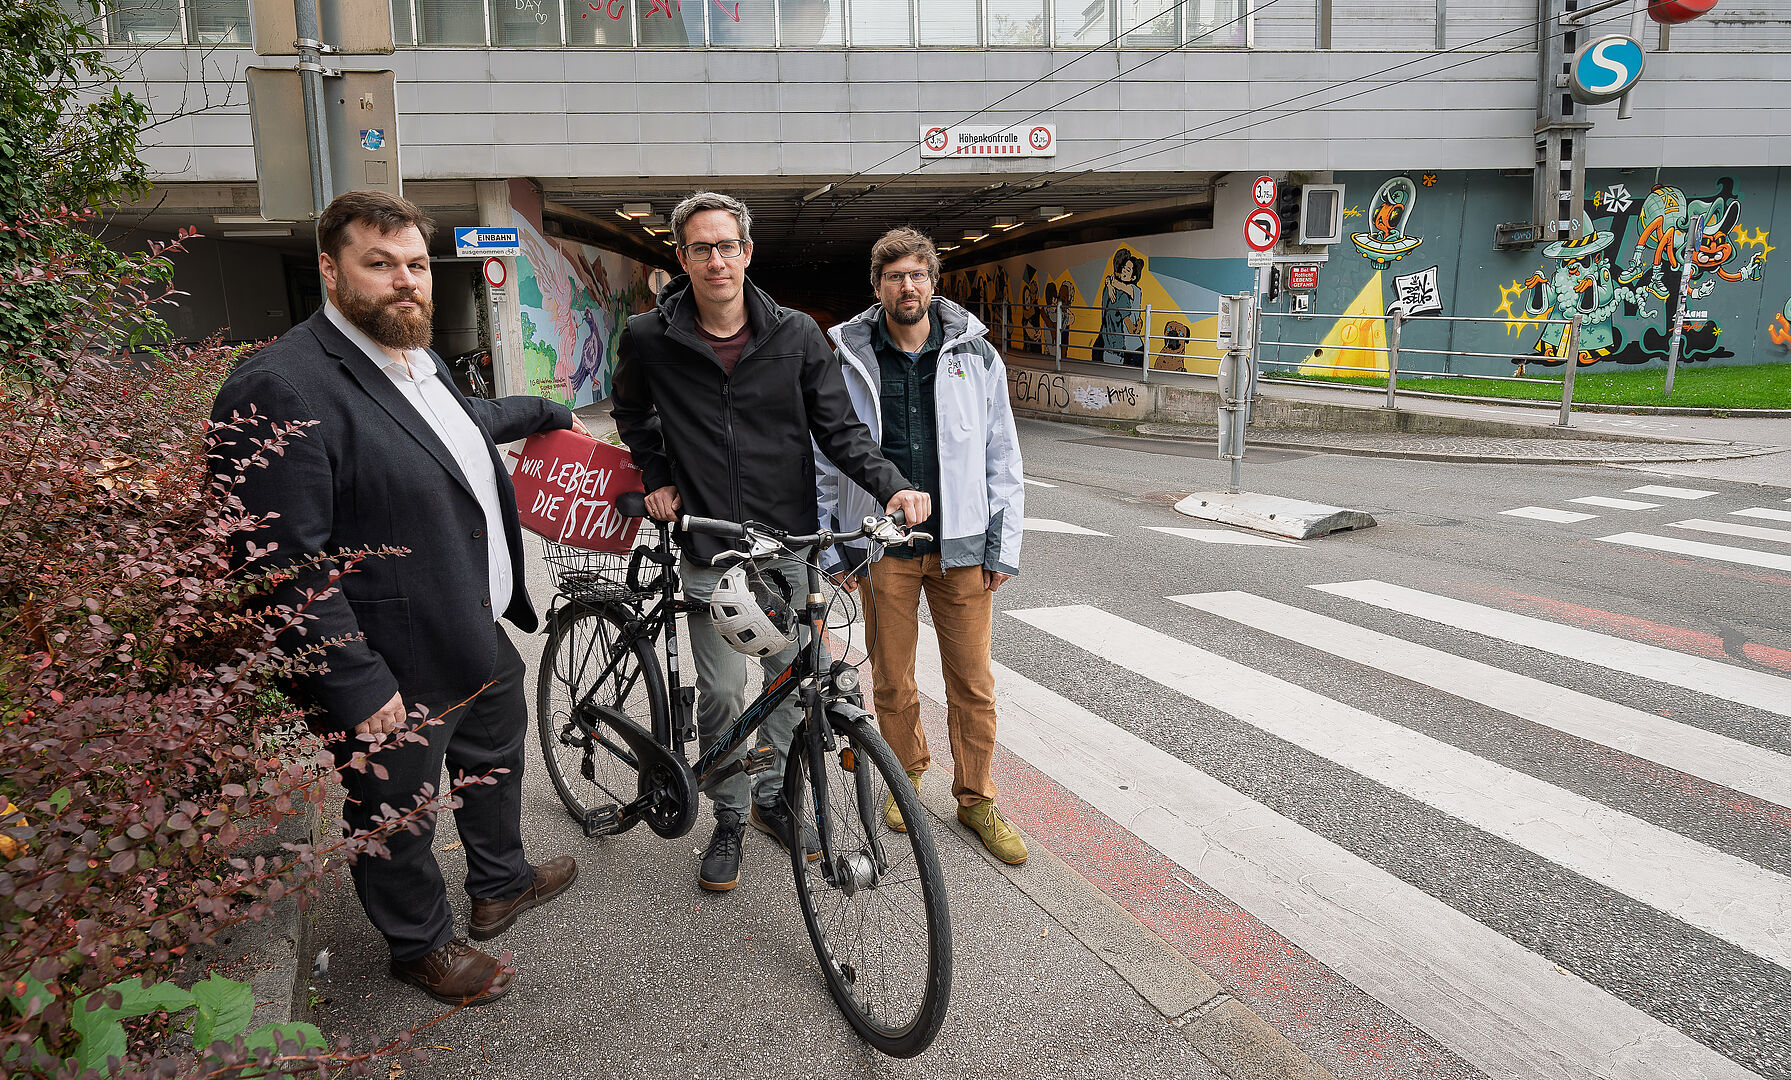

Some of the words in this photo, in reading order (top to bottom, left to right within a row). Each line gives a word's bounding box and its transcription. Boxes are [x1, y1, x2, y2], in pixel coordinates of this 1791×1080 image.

[1590, 38, 1628, 93] S
[958, 132, 1019, 143] Höhenkontrolle
[477, 234, 512, 242] EINBAHN
[520, 455, 544, 480] WIR
[546, 457, 613, 498] LEBEN
[531, 489, 565, 522] DIE
